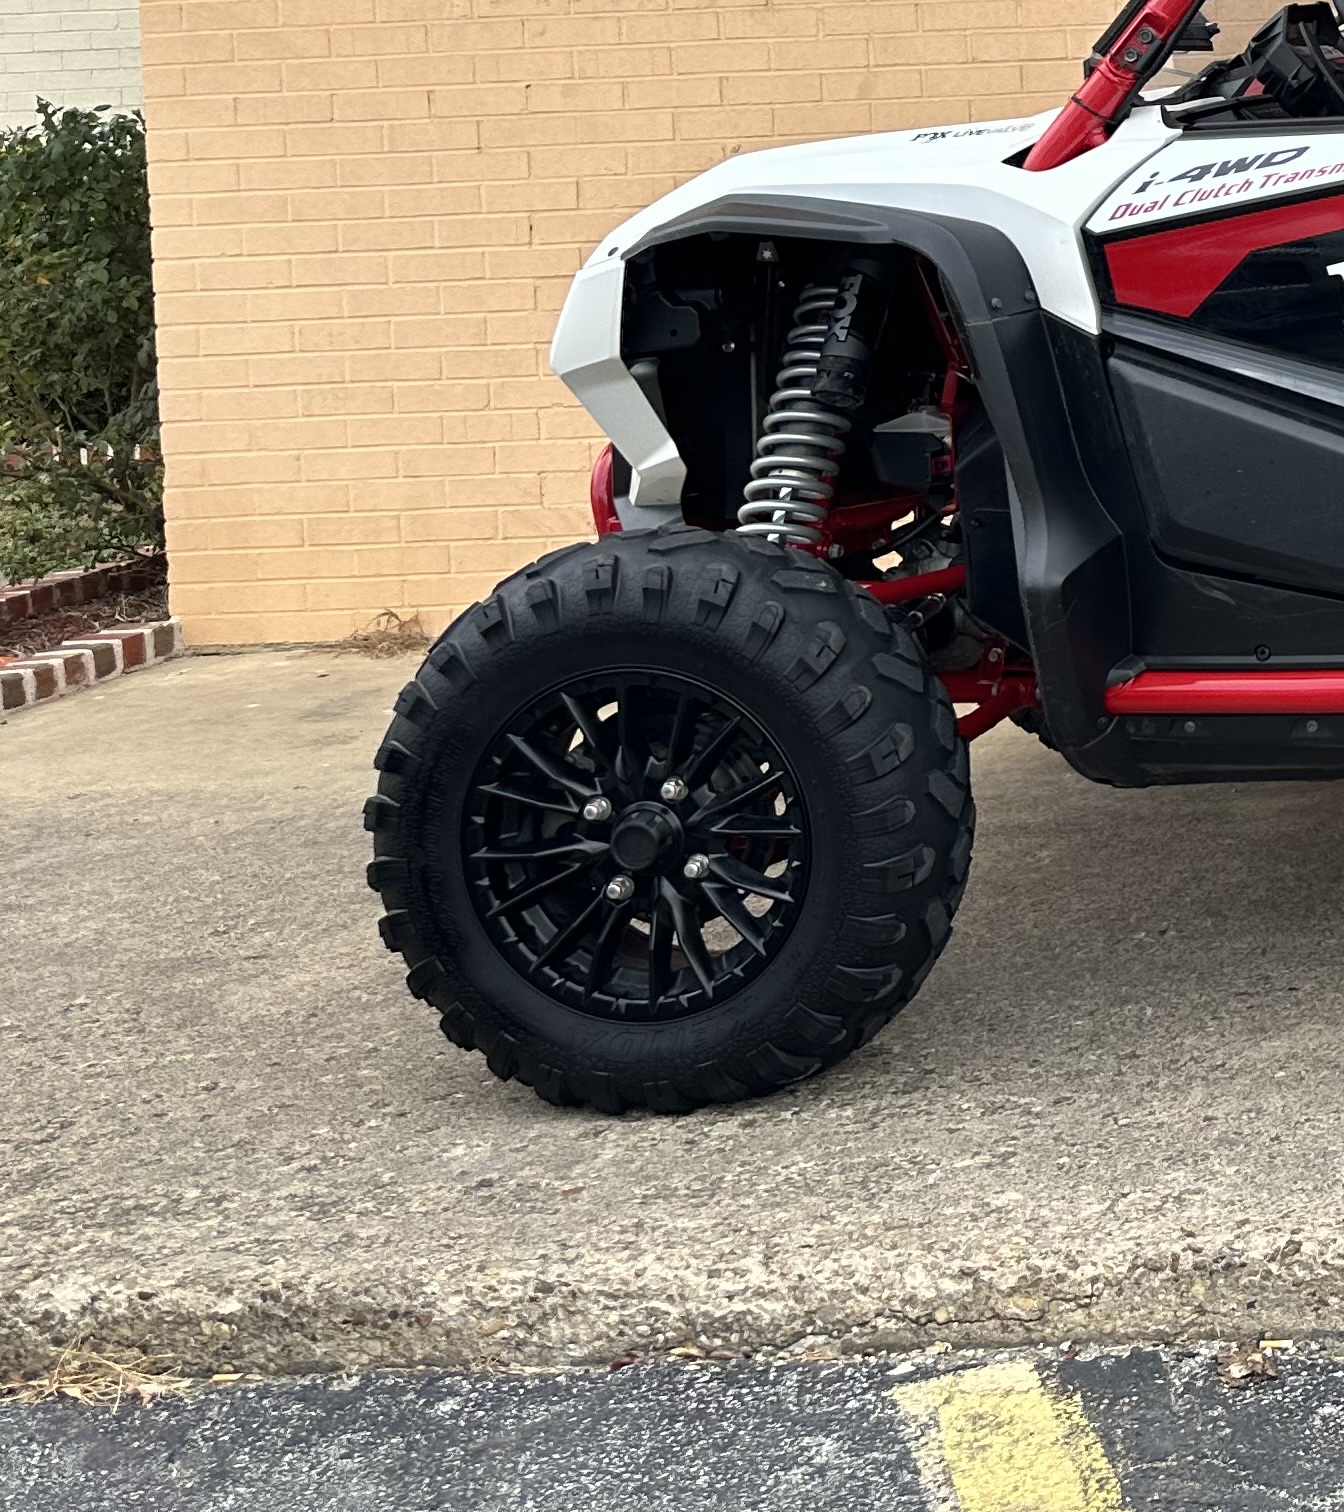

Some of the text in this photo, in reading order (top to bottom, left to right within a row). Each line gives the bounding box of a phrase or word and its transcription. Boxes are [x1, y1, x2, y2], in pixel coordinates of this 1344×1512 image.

[1132, 146, 1311, 195] i-4WD
[1107, 194, 1167, 222] Dual
[1173, 175, 1253, 208] Clutch
[826, 273, 864, 342] FOX
